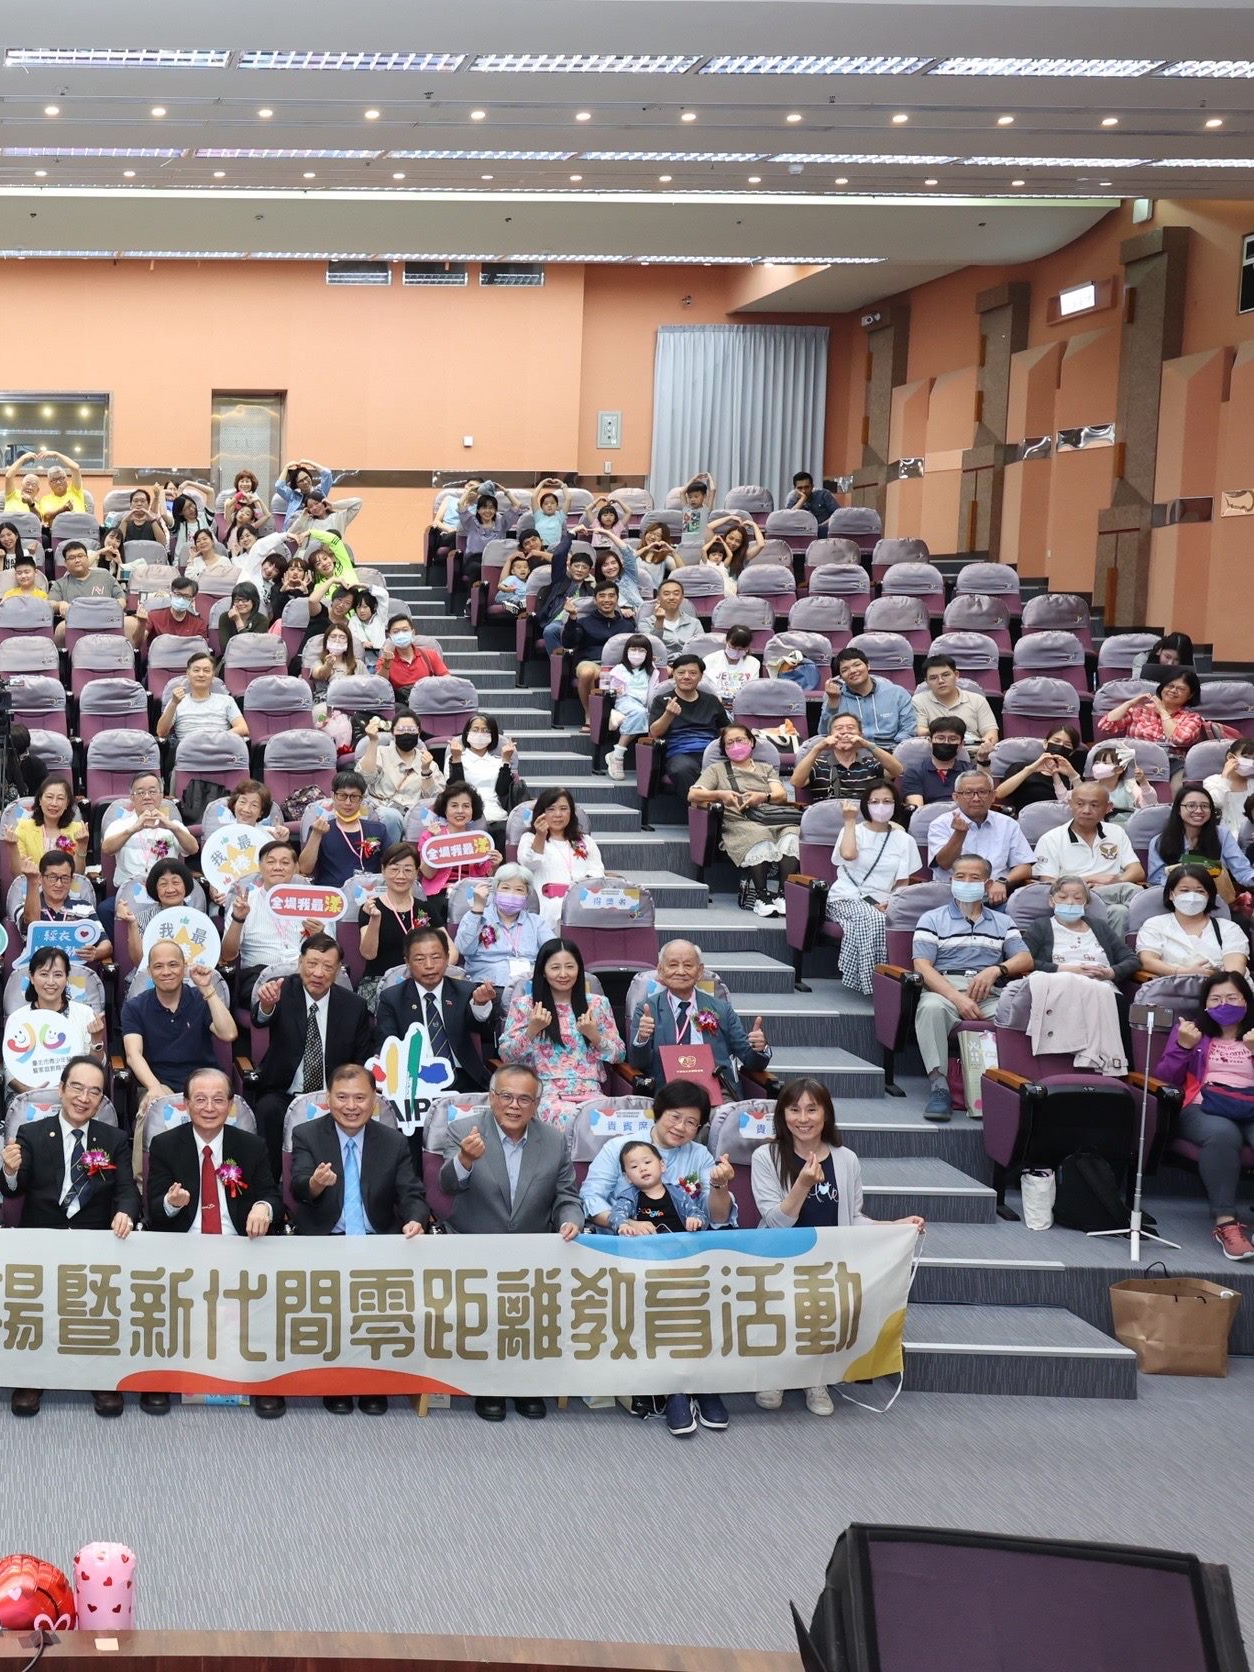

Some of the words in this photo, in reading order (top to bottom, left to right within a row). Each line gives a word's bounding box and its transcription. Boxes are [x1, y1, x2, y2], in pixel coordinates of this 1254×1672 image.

[271, 895, 342, 915] 全場我最漾
[608, 1120, 648, 1131] 貴賓席
